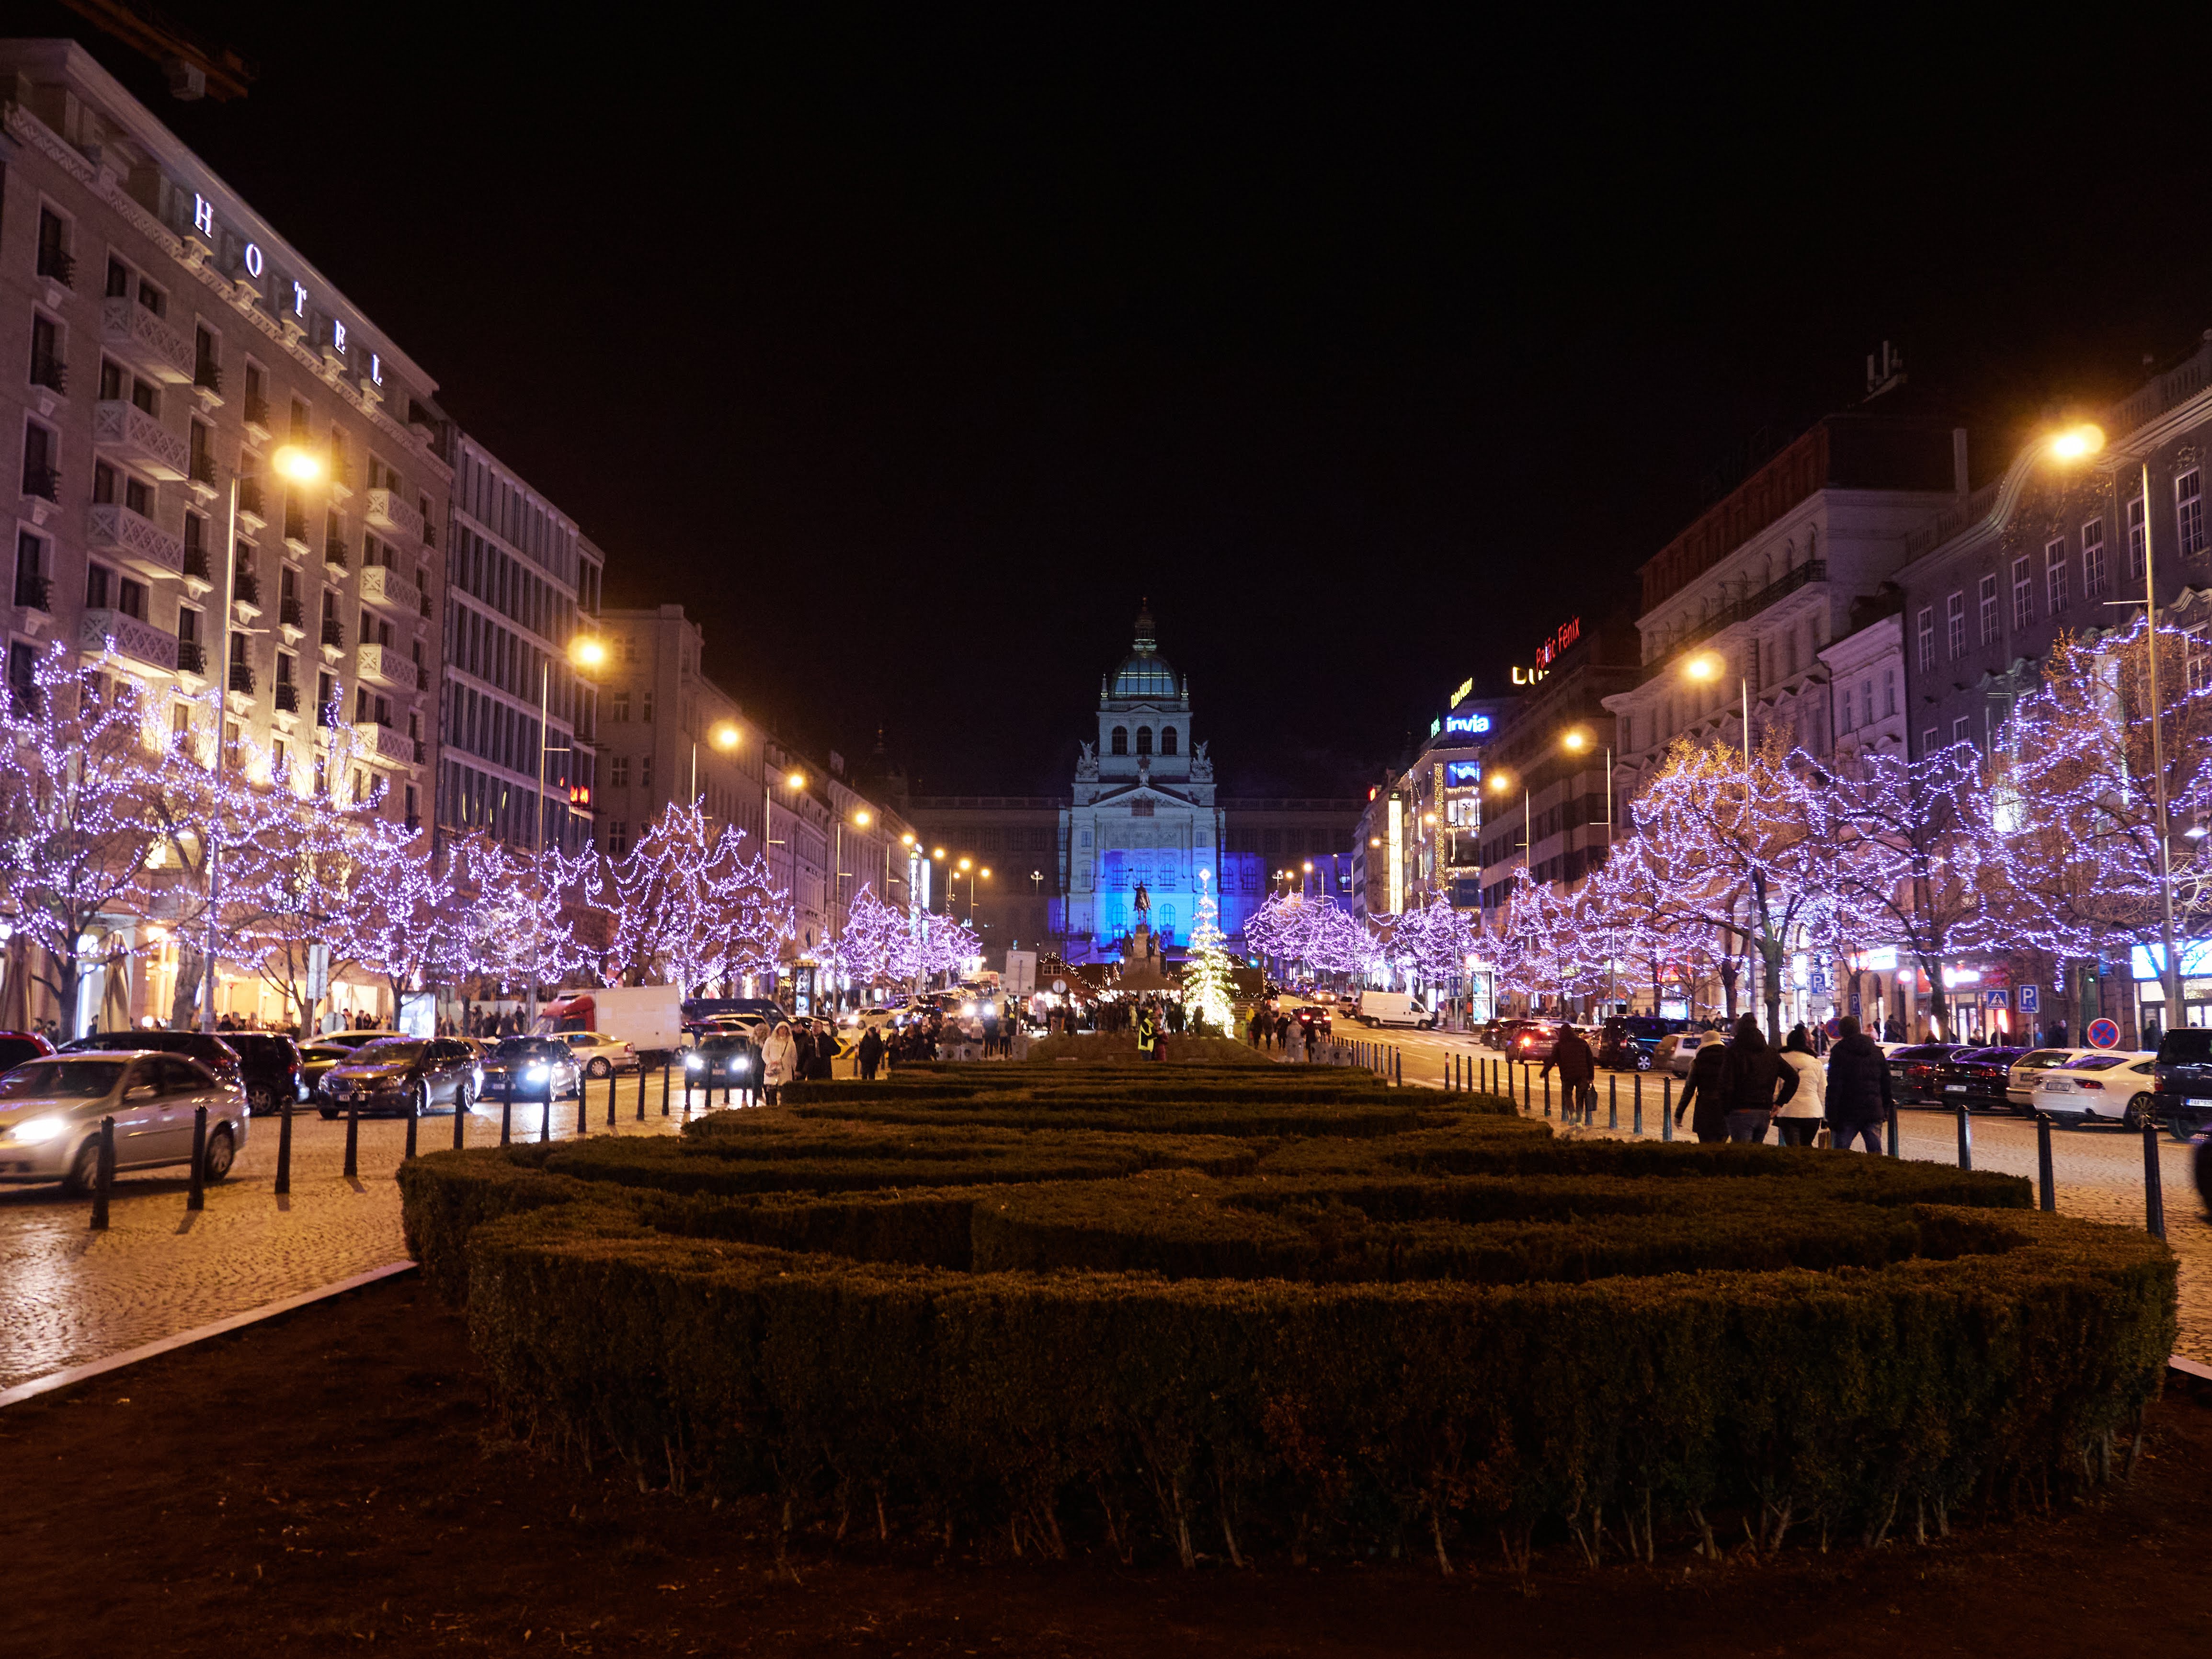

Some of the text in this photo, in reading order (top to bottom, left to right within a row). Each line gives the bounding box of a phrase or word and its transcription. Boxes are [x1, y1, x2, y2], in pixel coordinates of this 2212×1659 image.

[194, 193, 384, 386] HOTEL
[1558, 614, 1580, 653] Fénix
[1447, 714, 1490, 732] invia
[2023, 988, 2034, 1004] P
